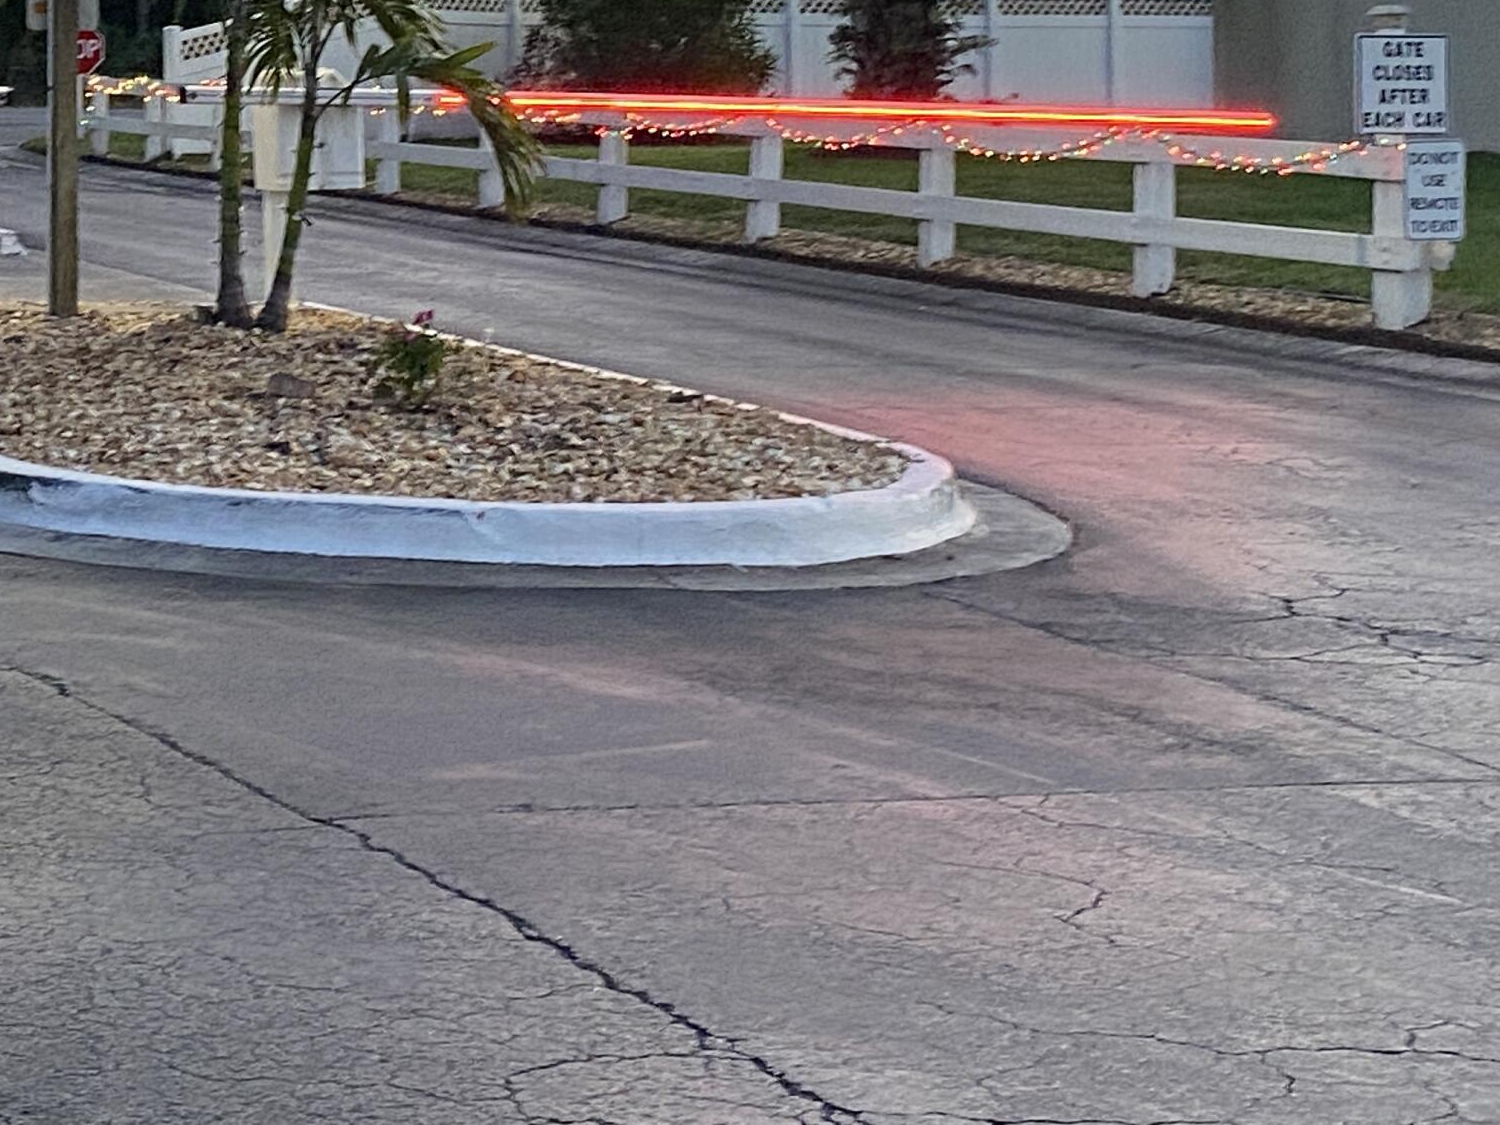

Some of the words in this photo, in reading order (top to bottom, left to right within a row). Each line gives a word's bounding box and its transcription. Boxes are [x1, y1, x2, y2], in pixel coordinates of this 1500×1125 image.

[76, 39, 100, 59] OP
[1382, 41, 1424, 57] GATE
[1373, 65, 1434, 81] CLOSED
[1379, 88, 1430, 105] AFTER
[1363, 112, 1405, 128] EACH
[1412, 112, 1446, 128] CAR
[1421, 174, 1447, 187] USE
